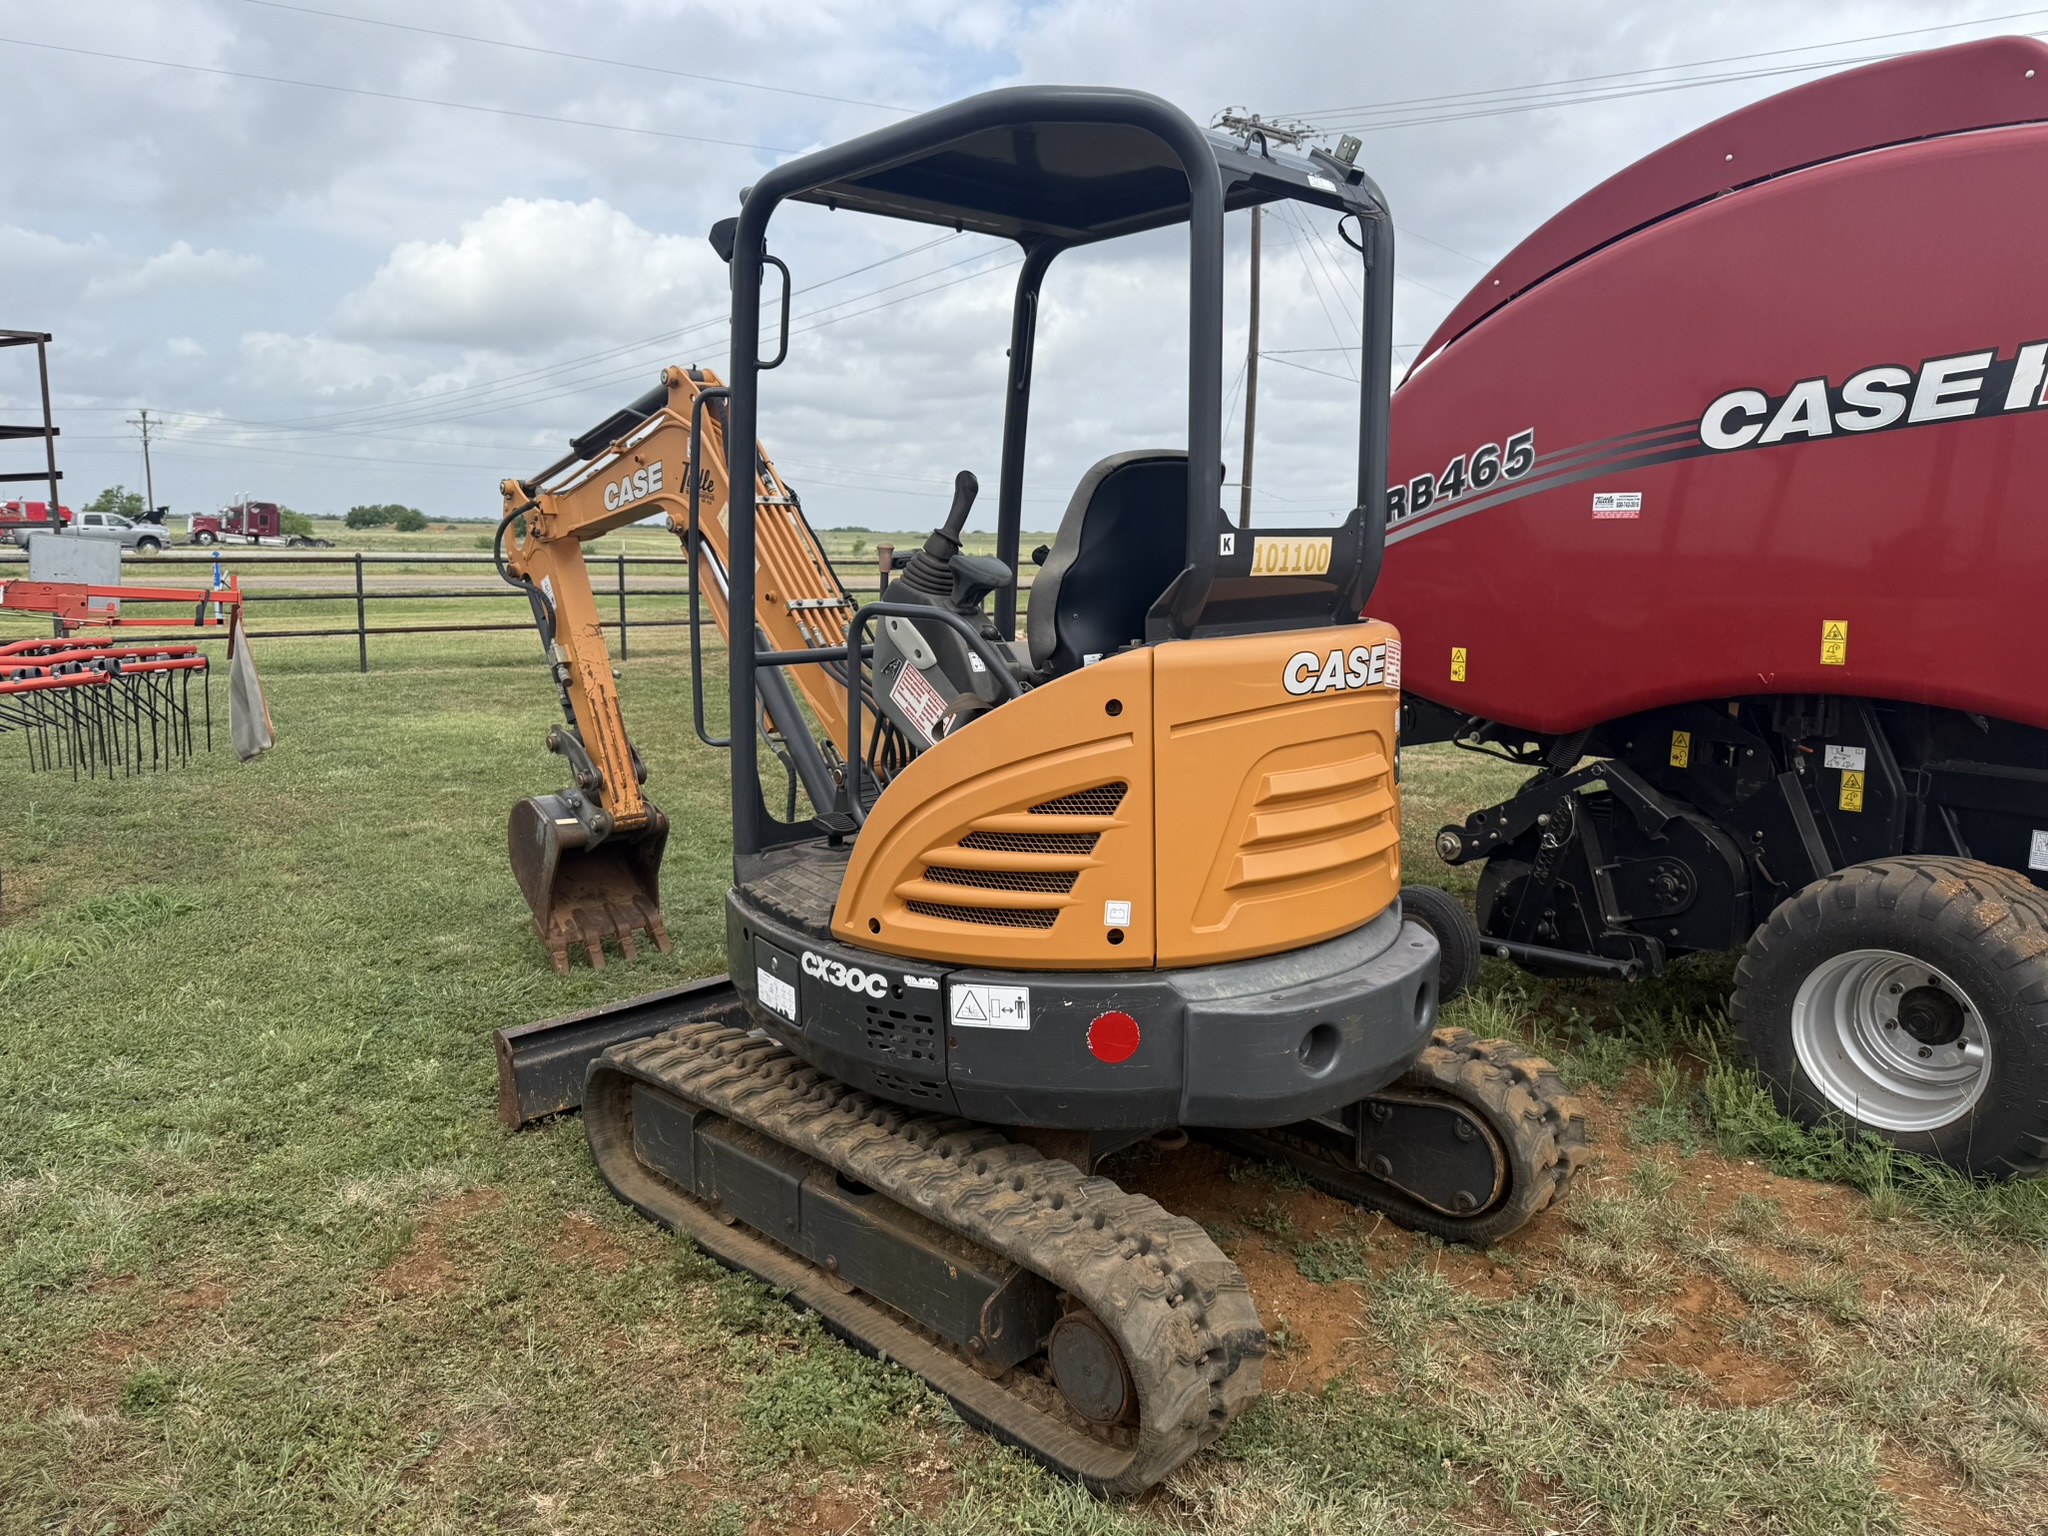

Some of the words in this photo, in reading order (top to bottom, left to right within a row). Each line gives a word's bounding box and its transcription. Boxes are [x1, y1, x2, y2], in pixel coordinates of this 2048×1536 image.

[1700, 351, 1993, 449] CASE
[603, 460, 663, 512] CASE
[1386, 427, 1535, 524] RB465
[1223, 537, 1231, 552] K
[1252, 543, 1329, 573] 101100
[1282, 643, 1386, 695] CASE
[801, 951, 888, 999] CX30C
